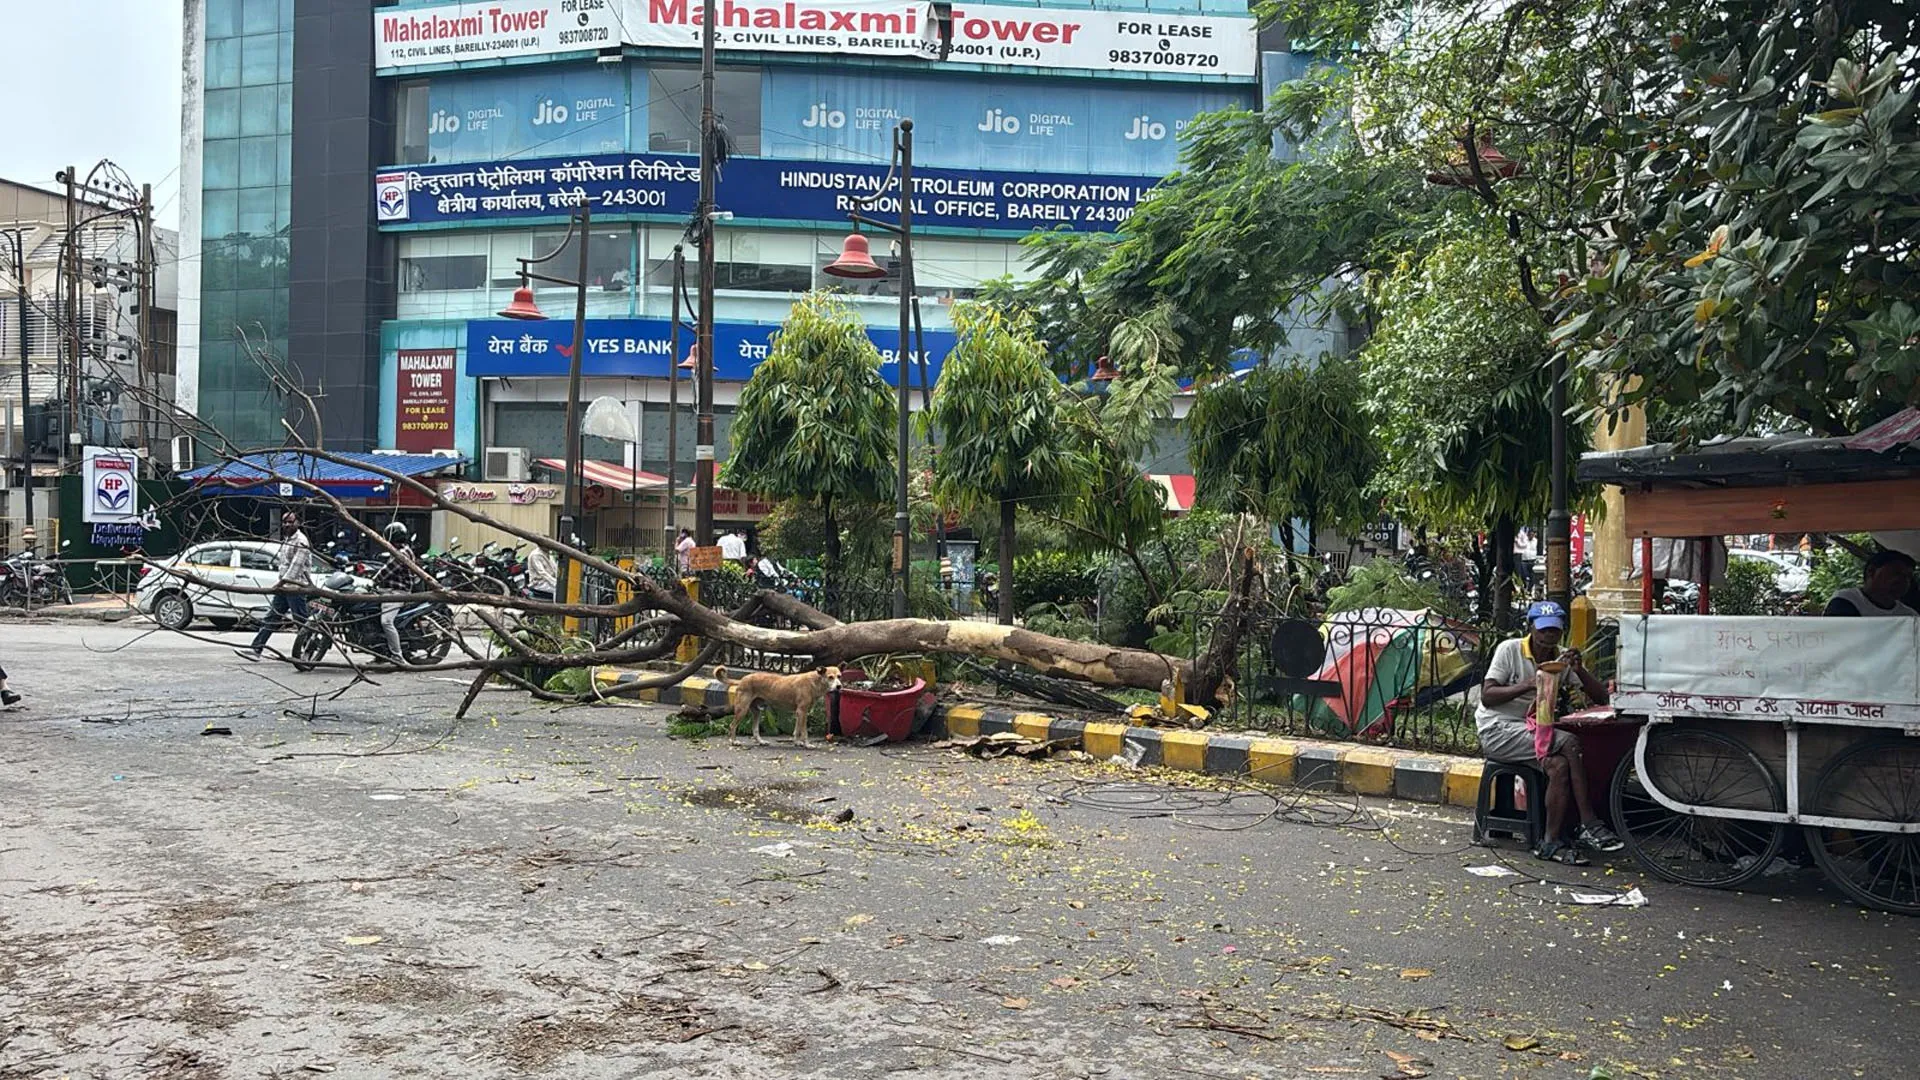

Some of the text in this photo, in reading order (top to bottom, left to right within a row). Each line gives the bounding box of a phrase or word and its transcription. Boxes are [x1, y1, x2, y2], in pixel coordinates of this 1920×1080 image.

[561, 0, 604, 13] FOR LEASE
[383, 8, 549, 43] Mahalaxmi Tower
[1118, 22, 1213, 38] FOR LEASE
[559, 27, 609, 45] 9837008720
[391, 49, 407, 59] 112,
[408, 47, 428, 58] CIVIL
[429, 44, 453, 57] LINES,
[521, 37, 540, 49] (U.P.)
[691, 31, 727, 44] 12,
[733, 32, 781, 44] CIVIL
[786, 34, 842, 48] LINES,
[1000, 46, 1041, 60] (U.P.)
[1108, 50, 1219, 67] 9837008720
[532, 100, 568, 125] Jio
[576, 98, 615, 110] DIGITAL
[429, 109, 460, 134] Jio
[467, 108, 504, 120] DIGITAL
[575, 110, 598, 122] LIFE
[802, 103, 846, 128] Jio
[855, 108, 901, 120] DIGITAL
[978, 108, 1020, 134] Jio
[1030, 113, 1074, 126] DIGITAL
[467, 120, 488, 131] LIFE
[855, 120, 881, 130] LIFE
[1030, 125, 1055, 136] LIFE
[1125, 116, 1166, 140] Jio
[407, 171, 475, 194] हिन्दुस्तान
[477, 166, 545, 190] पेट्रोलियम
[629, 159, 701, 182] लिमिटेड
[780, 171, 880, 191] HINDUSTAN
[888, 178, 994, 196] PTROLEUM
[1002, 182, 1129, 202] CORPORATION
[384, 192, 398, 201] HP
[437, 193, 477, 213] क्षेत्रीय
[480, 190, 545, 211] कार्यालय,
[934, 199, 1000, 220] OFFICE,
[1007, 203, 1081, 221] BAREILY
[488, 333, 549, 354] येस बैंक
[587, 339, 673, 354] YES BANK
[739, 340, 768, 359] येस
[400, 355, 453, 370] MAHALAXMI
[411, 373, 442, 388] TOWER
[105, 479, 122, 490] HP
[1571, 515, 1580, 565] SALE
